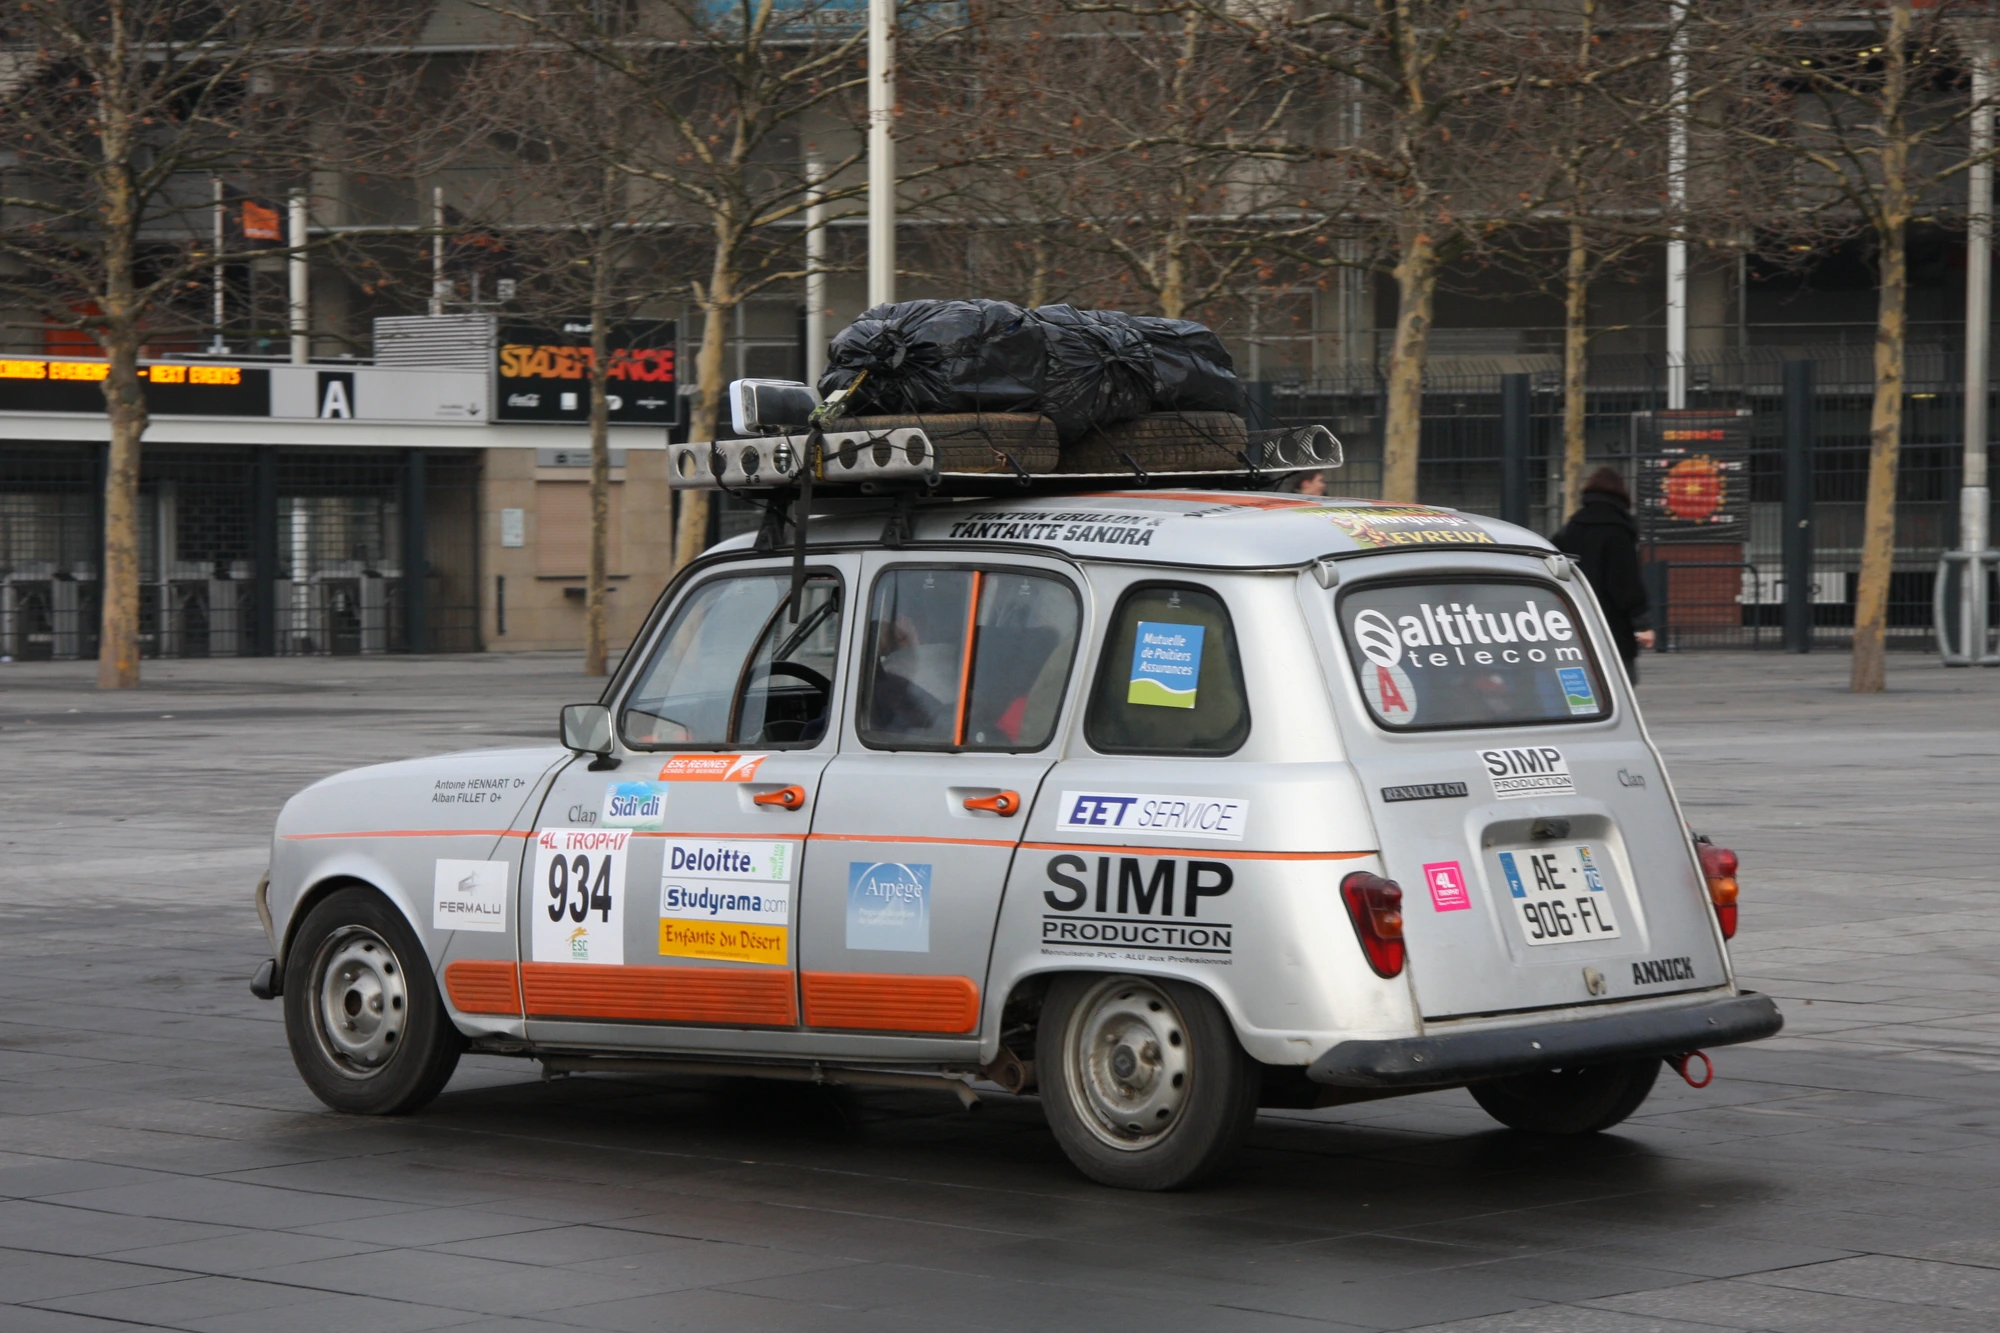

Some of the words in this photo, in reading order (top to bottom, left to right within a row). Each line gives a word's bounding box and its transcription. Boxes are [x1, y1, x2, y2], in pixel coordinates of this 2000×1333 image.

[150, 365, 187, 383] NEXT
[189, 367, 242, 385] EVENTS
[320, 380, 352, 419] A
[964, 512, 1049, 521] TONTON
[1051, 512, 1149, 526] GRILLON
[949, 522, 1064, 541] TANTANTE
[1063, 526, 1155, 546] SANDRA
[1389, 531, 1496, 545] EVREUX
[1398, 600, 1574, 648] altitude
[1143, 632, 1187, 647] Mutuelle
[1141, 647, 1154, 659] de
[1153, 648, 1192, 662] Poitiers
[1407, 646, 1584, 669] telecom
[1138, 661, 1194, 676] Assurances
[1376, 665, 1410, 713] A
[667, 759, 687, 769] ESC
[687, 759, 730, 769] RENNES
[1482, 748, 1562, 777] SIMP
[434, 780, 466, 790] Antoine
[467, 778, 510, 789] HENNART
[1384, 785, 1435, 800] RENAULT
[1435, 784, 1446, 796] 4
[1444, 782, 1468, 795] GTL
[1494, 776, 1572, 790] PRODUCTION
[432, 793, 456, 803] Alban
[456, 792, 487, 803] FILLET
[609, 796, 637, 817] Sidi
[640, 796, 660, 816] ali
[568, 805, 597, 826] Clan
[1069, 795, 1138, 826] EET
[1138, 800, 1239, 831] SERVICE
[539, 832, 558, 849] 4L
[566, 832, 629, 850] TROPHY
[547, 853, 613, 923] 934
[864, 876, 924, 903] Arpège
[1043, 853, 1234, 918] SIMP
[1436, 872, 1456, 889] 4L
[1584, 870, 1603, 889] 76
[439, 901, 502, 915] FERMALU
[665, 886, 787, 916] Studyrama.com
[1523, 896, 1614, 939] 906-FL
[665, 924, 716, 947] Enfants
[719, 932, 737, 948] du
[740, 930, 781, 951] Désert
[1042, 921, 1231, 948] PRODUCTION
[572, 939, 589, 952] ESC
[1096, 952, 1117, 960] PVC
[1124, 954, 1145, 962] ALU
[1631, 957, 1696, 985] ANNICK
